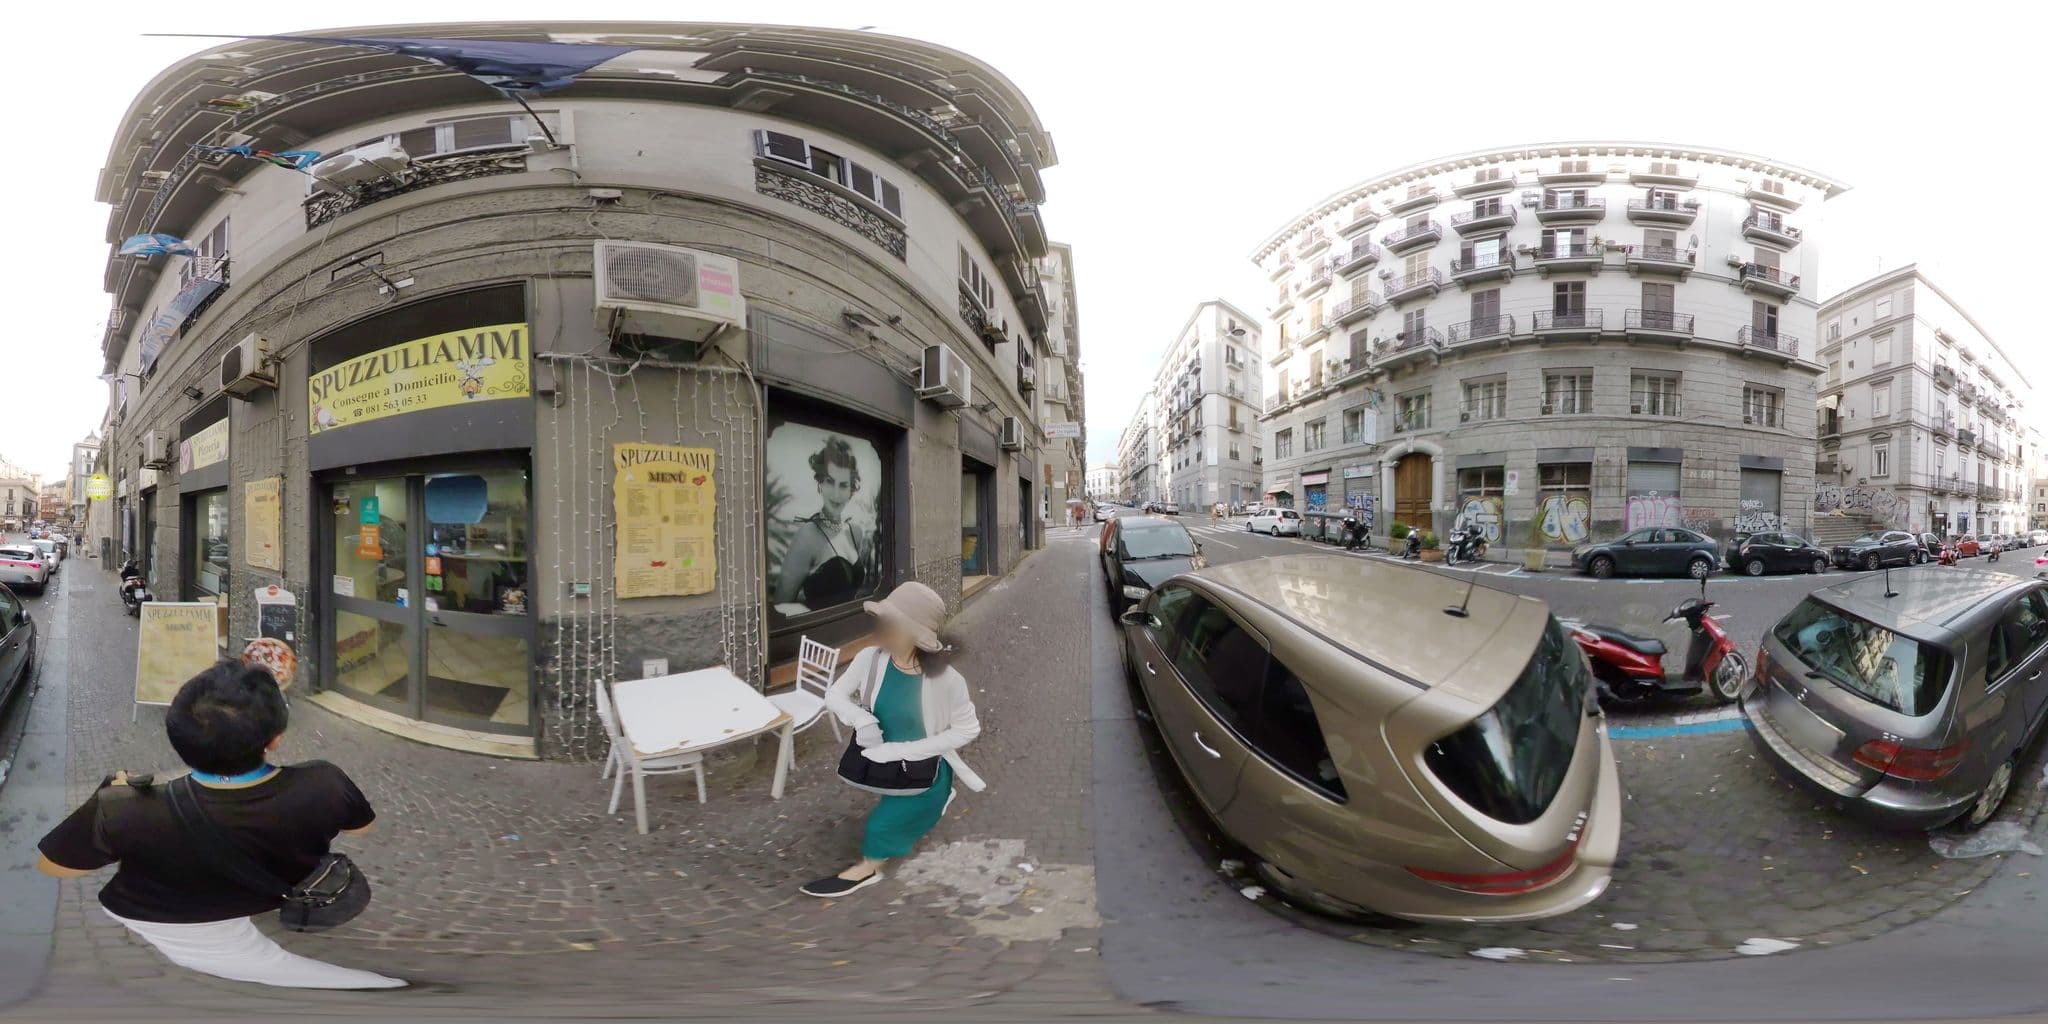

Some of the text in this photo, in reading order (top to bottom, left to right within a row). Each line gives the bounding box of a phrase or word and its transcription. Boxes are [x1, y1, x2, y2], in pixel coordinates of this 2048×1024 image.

[312, 329, 522, 404] SPUZZULIAMM
[332, 373, 456, 410] Consegne a Domicilio
[365, 405, 380, 415] 081
[620, 448, 710, 472] SPUZZULIAMM
